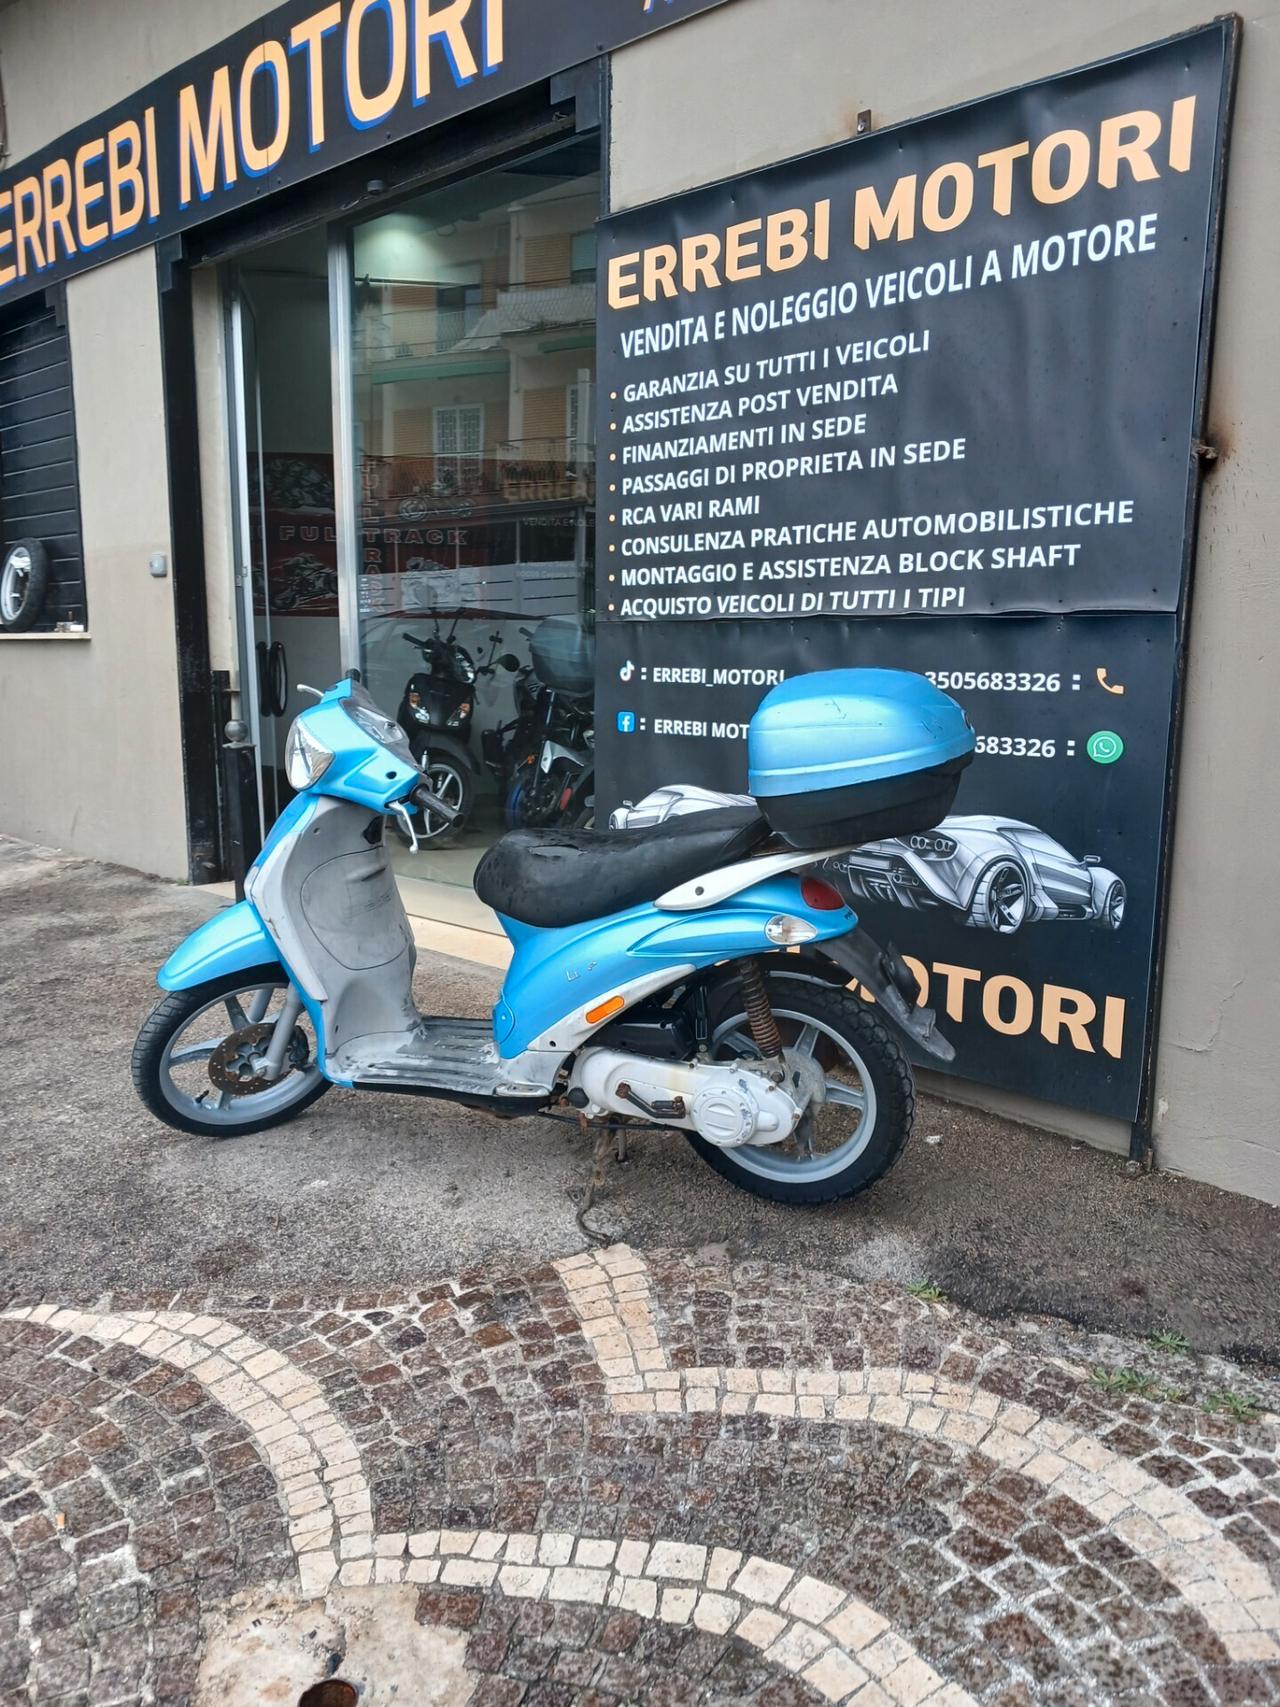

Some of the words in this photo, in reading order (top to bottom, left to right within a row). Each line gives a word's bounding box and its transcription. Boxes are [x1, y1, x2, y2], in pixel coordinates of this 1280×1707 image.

[608, 199, 830, 309] ERREBI
[854, 95, 1196, 250] MOTORI
[621, 316, 708, 358] VENDITA
[715, 311, 725, 339] E
[733, 282, 857, 336] NOLEGGIO
[865, 256, 972, 308] VEICOLI
[981, 250, 1001, 285] A
[1012, 213, 1157, 278] MOTORE
[624, 370, 719, 402] GARANZIA
[725, 363, 749, 385] SU
[757, 351, 815, 379] TUTTI
[824, 348, 828, 367] I
[836, 330, 929, 364] VEICOLI
[623, 400, 732, 433] ASSISTENZA
[739, 390, 791, 416] POST
[796, 374, 898, 406] VENDITA
[623, 427, 773, 464] FINANZIAMENTI
[781, 422, 804, 443] IN
[812, 414, 866, 439] SEDE
[623, 468, 708, 495] PASSAGGI
[716, 465, 735, 484] DI
[743, 450, 863, 481] PROPRIETA
[871, 446, 895, 467] IN
[904, 438, 965, 464] SEDE
[280, 525, 338, 542] FUL
[622, 531, 745, 556] CONSULENZA
[751, 521, 856, 547] PRATICHE
[863, 501, 1133, 539] AUTOMOBILISTICHE
[623, 507, 656, 525] RCA
[660, 502, 702, 521] VARI
[709, 496, 759, 517] RAMI
[622, 564, 736, 585] MONTAGGIO
[743, 563, 753, 580] E
[759, 555, 891, 579] ASSISTENZA
[899, 549, 984, 573] BLOCK
[991, 544, 1080, 568] SHAFT
[621, 597, 711, 618] ACQUISTO
[717, 594, 794, 613] VEICOLI
[801, 593, 823, 611] DI
[830, 590, 895, 610] TUTTI
[904, 589, 910, 608] I
[919, 587, 965, 607] TIPI
[653, 667, 784, 687] ERREBI_MOTORI
[925, 671, 1061, 692] 3505683326
[655, 719, 706, 736] ERREBI
[845, 955, 1126, 1060] TORI
